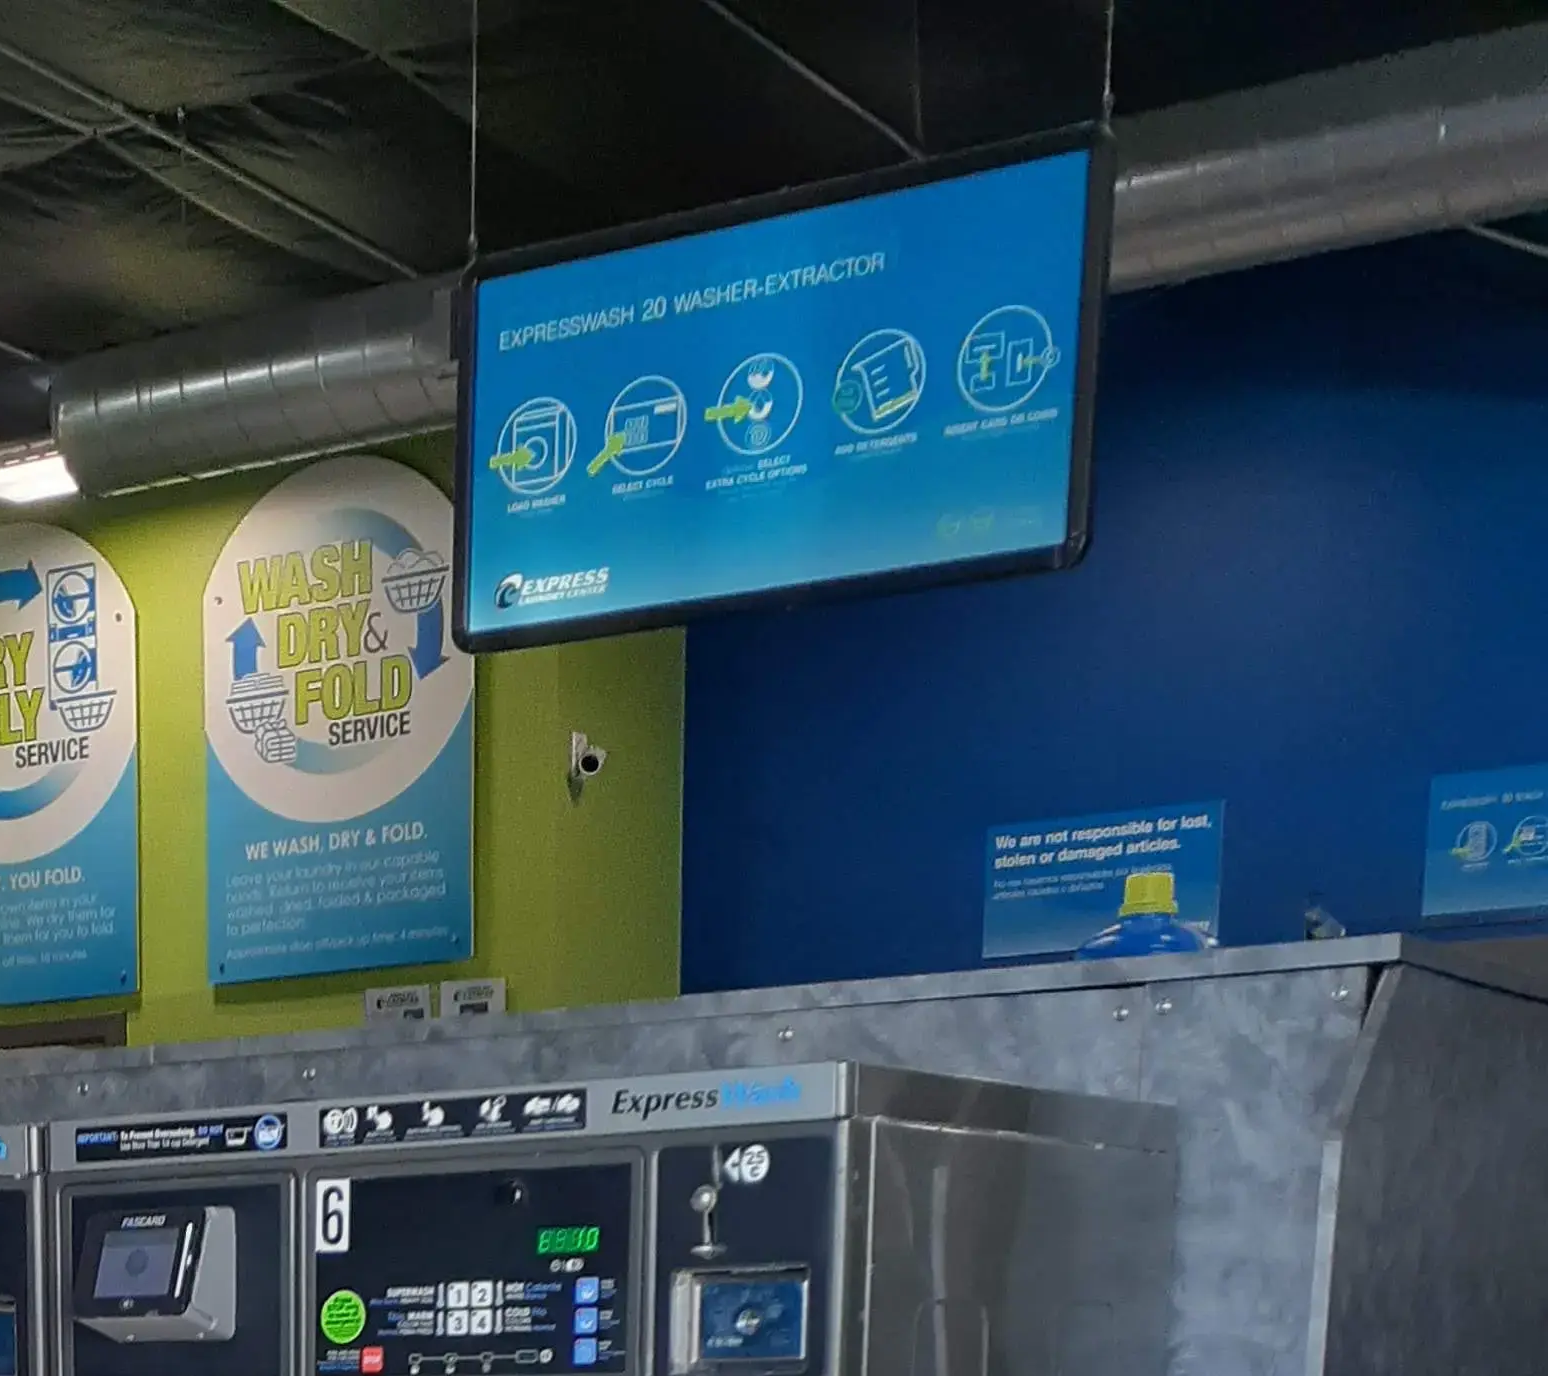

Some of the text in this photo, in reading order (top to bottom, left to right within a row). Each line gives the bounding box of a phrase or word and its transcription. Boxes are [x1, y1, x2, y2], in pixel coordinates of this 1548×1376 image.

[499, 251, 886, 351] EXPRESSWASH 20 WASHER-EXTRACTOR
[237, 537, 373, 616] WASH
[521, 566, 610, 596] EXPRESS
[294, 654, 413, 726] FOLD
[328, 710, 411, 746] SERVICE
[15, 736, 90, 769] SERVICE
[245, 821, 428, 861] WE WASH, DRY & FOLD.
[995, 813, 1212, 849] We are not responsible for lost,
[994, 837, 1181, 870] stolen or damaged articles.
[8, 870, 41, 891] YOU
[44, 865, 85, 886] FOLD.
[746, 1150, 766, 1165] 25
[121, 1214, 167, 1229] FASCARD
[321, 1185, 344, 1245] 6
[478, 1288, 488, 1303] 2
[454, 1317, 463, 1331] 3
[477, 1315, 487, 1330] 4
